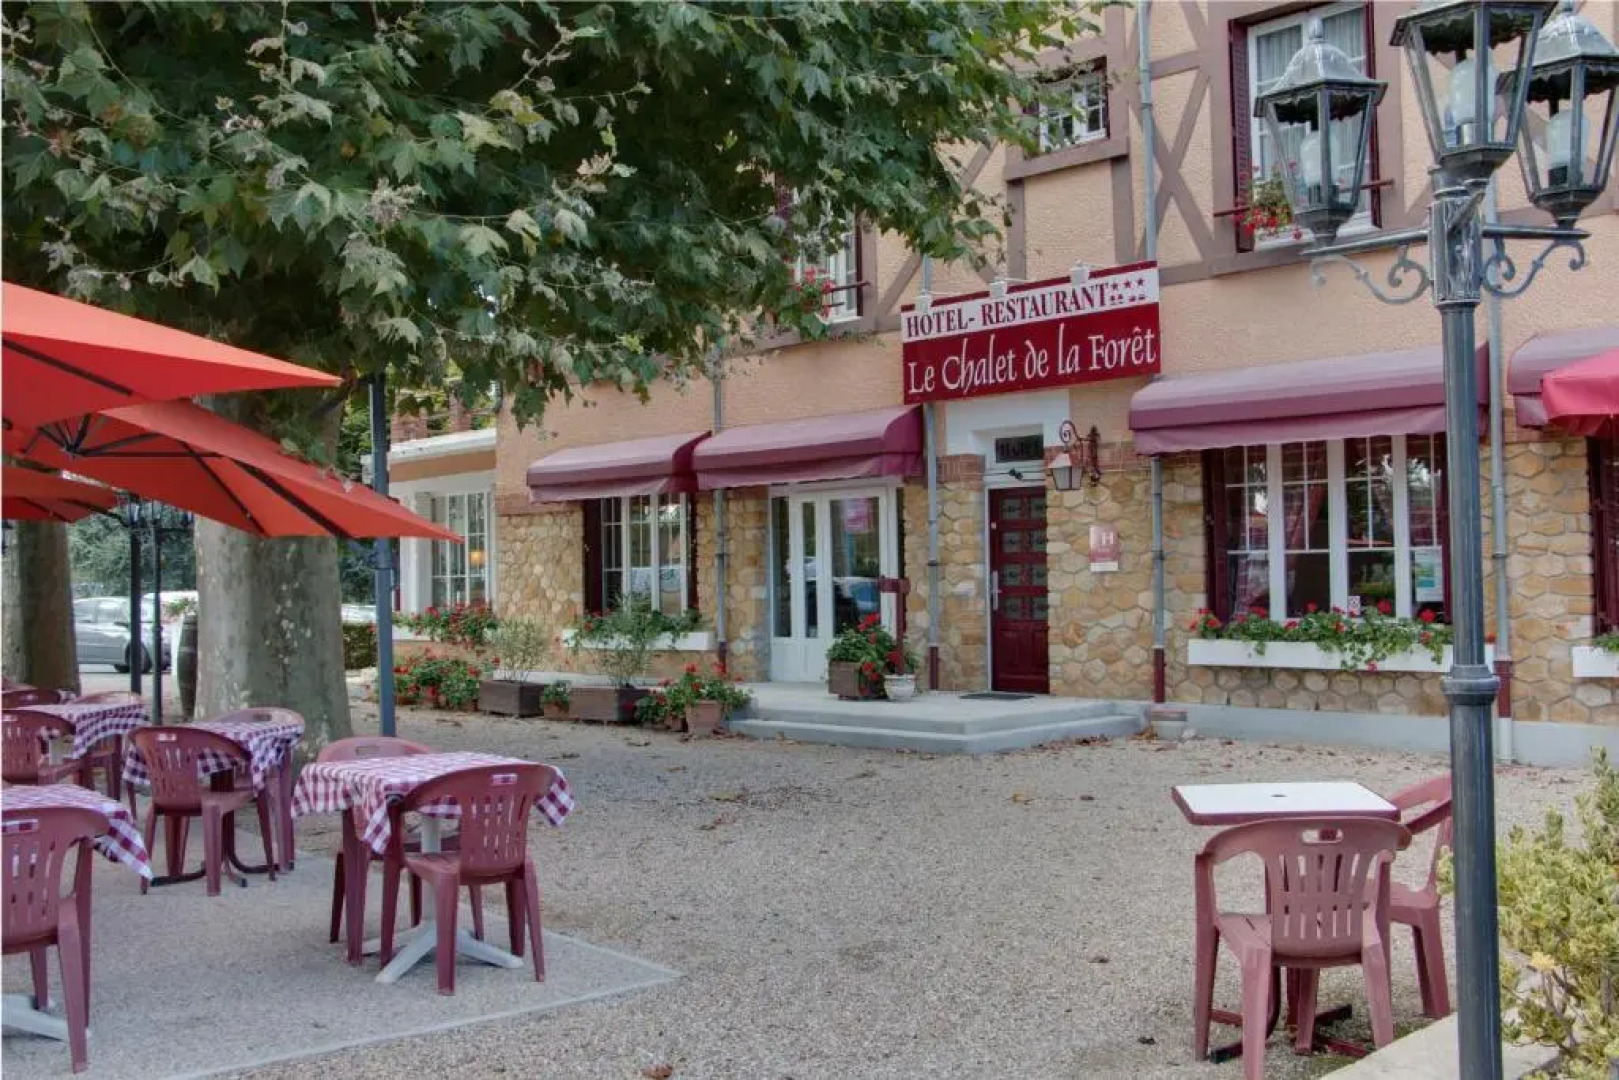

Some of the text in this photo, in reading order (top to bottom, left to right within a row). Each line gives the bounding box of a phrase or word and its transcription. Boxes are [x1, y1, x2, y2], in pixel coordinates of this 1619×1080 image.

[981, 282, 1109, 326] RESTAURANT
[908, 324, 1157, 395] Le Chalet de la Forêt
